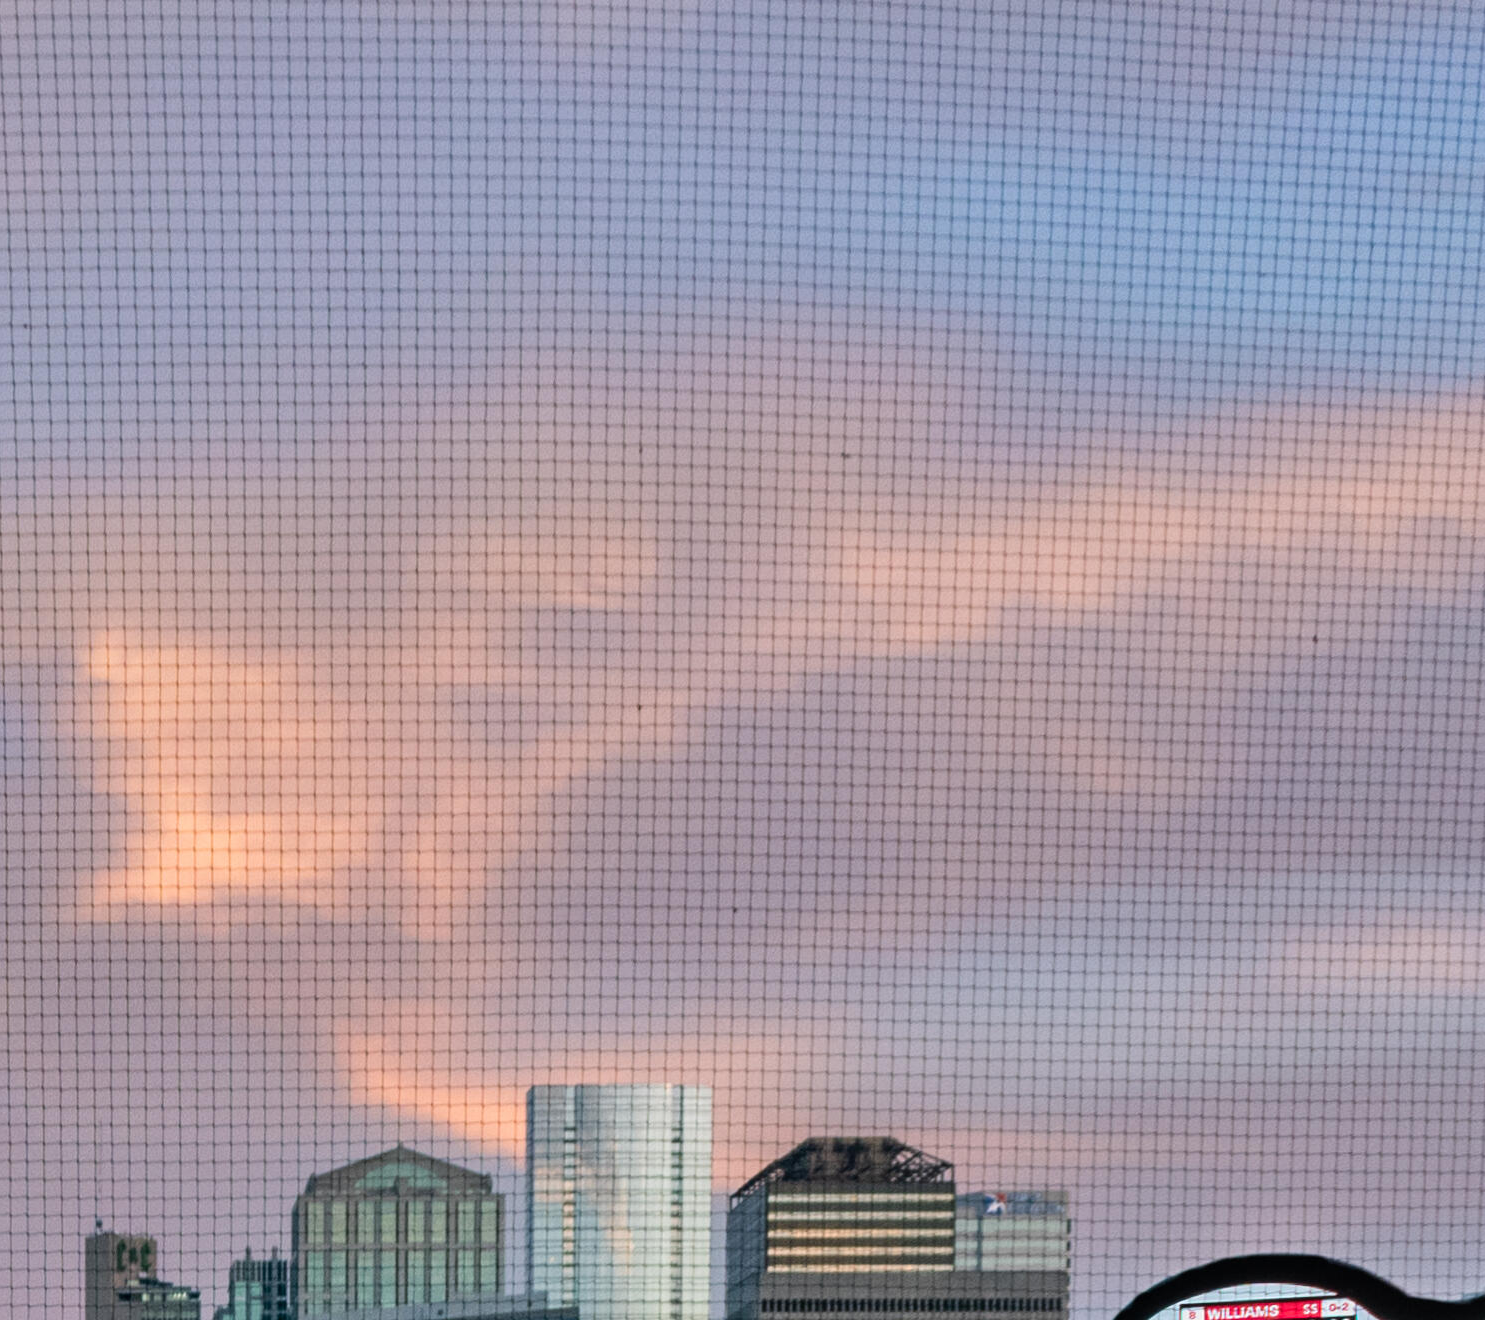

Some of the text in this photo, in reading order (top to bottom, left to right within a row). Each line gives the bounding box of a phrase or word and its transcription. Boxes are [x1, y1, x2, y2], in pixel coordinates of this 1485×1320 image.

[1207, 1303, 1349, 1320] WILLIAMS SS 0-2
